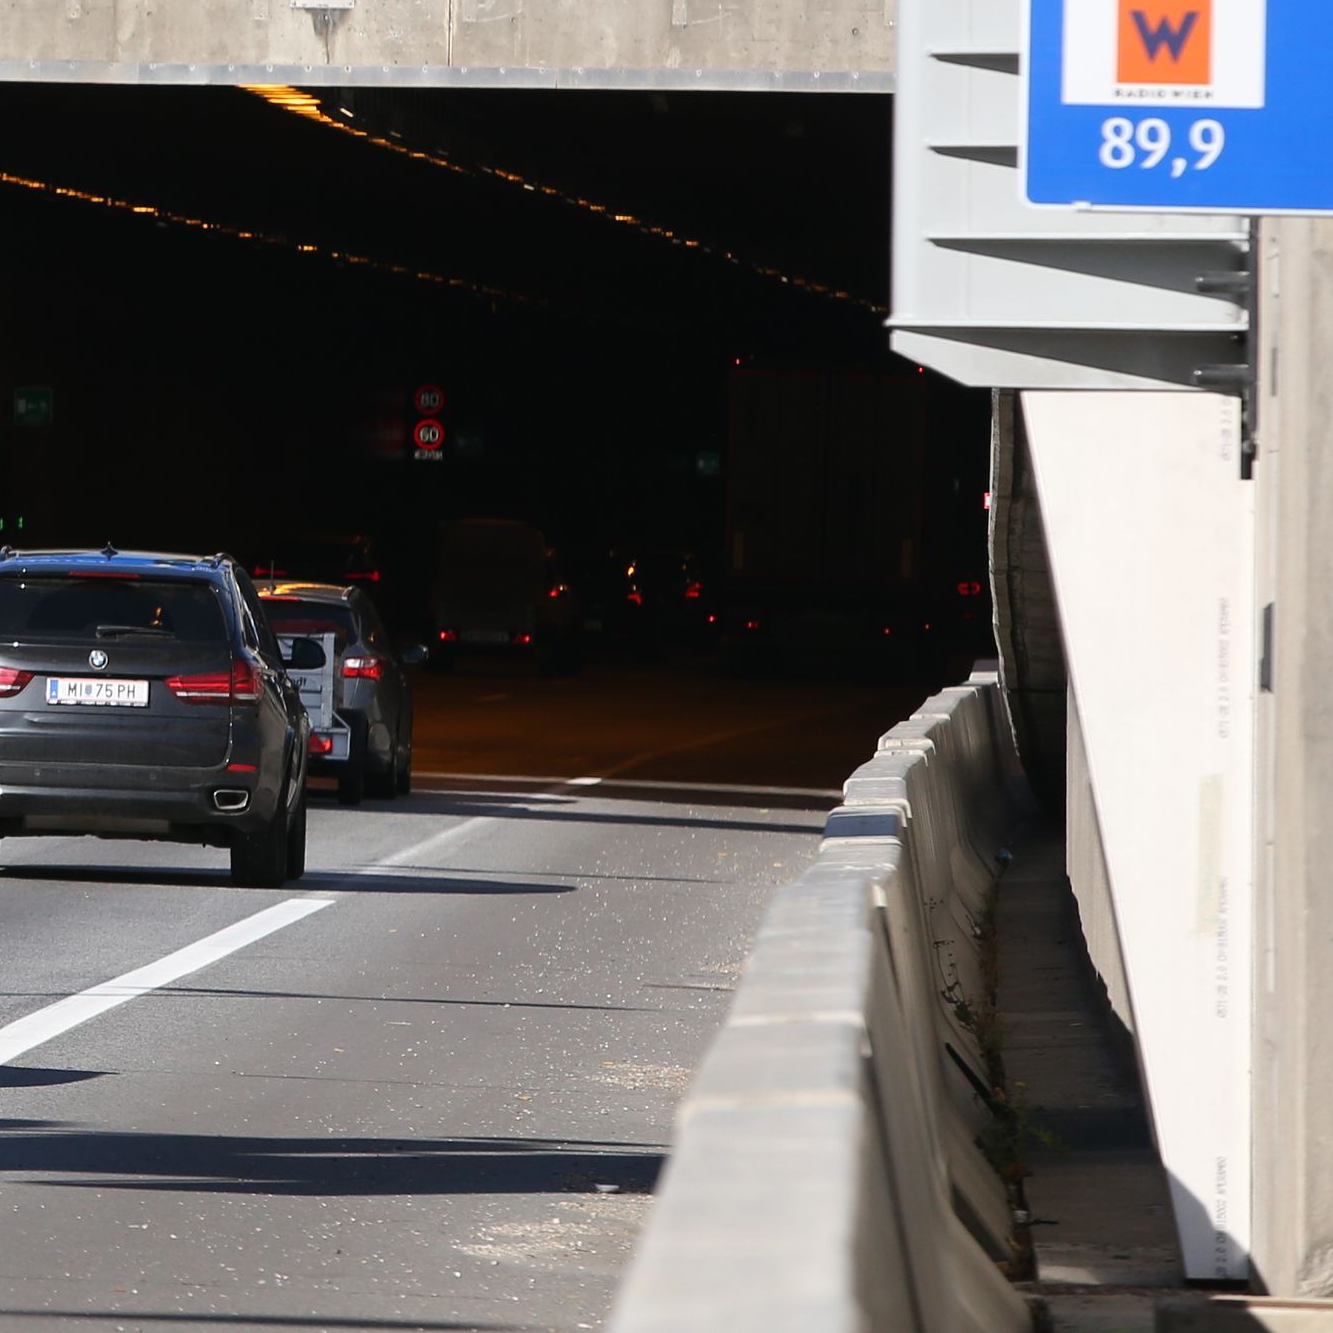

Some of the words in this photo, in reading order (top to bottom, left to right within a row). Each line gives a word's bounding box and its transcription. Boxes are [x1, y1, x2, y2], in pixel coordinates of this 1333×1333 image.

[1130, 10, 1199, 64] W
[1098, 117, 1226, 178] 89,9
[420, 426, 439, 442] 60
[67, 683, 82, 697] MI
